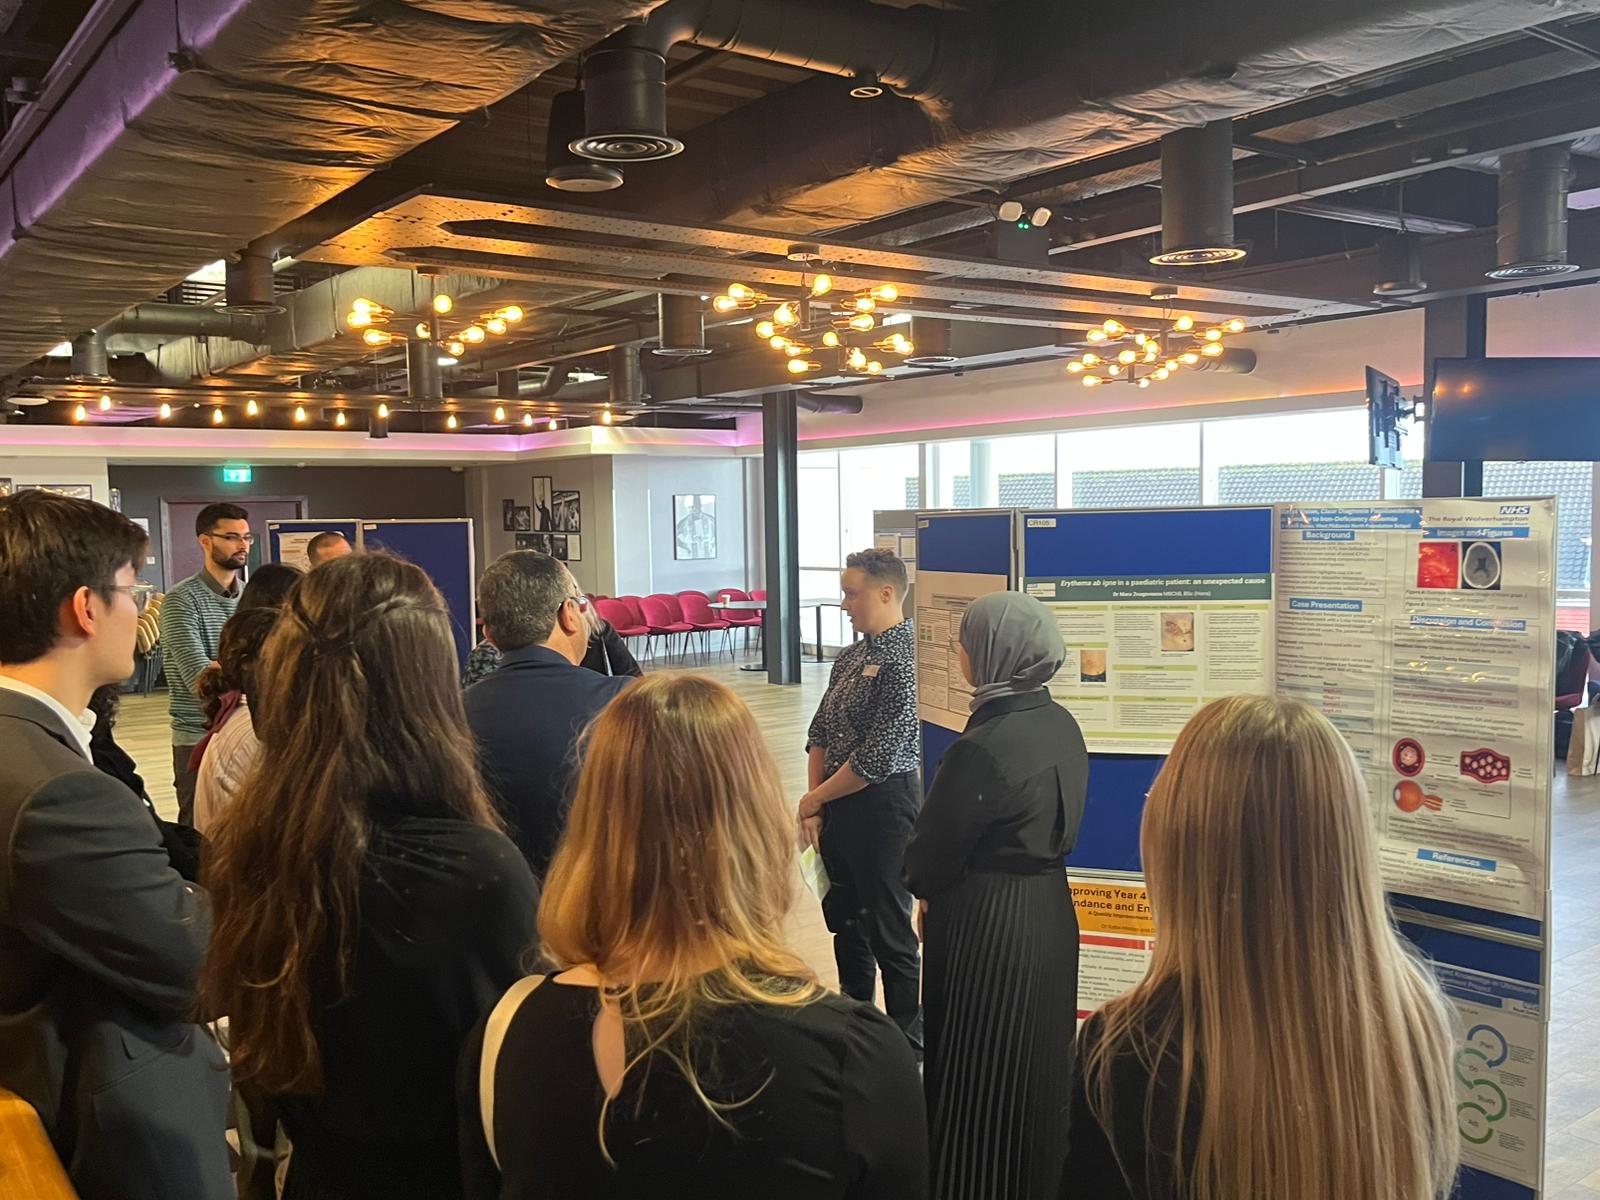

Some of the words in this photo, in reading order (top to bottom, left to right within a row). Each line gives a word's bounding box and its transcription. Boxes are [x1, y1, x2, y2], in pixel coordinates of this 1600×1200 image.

[1500, 506, 1530, 514] NHS
[1305, 530, 1352, 540] Background
[1060, 579, 1092, 588] Erythema
[1103, 579, 1117, 588] igne
[1131, 578, 1164, 587] paediatric
[1291, 600, 1309, 608] Case
[1310, 601, 1360, 610] Presentation
[1412, 616, 1457, 626] Discussion
[1475, 619, 1524, 629] Consion
[1432, 852, 1481, 867] References
[1069, 888, 1112, 899] proving
[1114, 890, 1138, 900] Year
[1139, 892, 1147, 900] 4
[1074, 899, 1113, 910] ndance
[1115, 903, 1135, 912] and
[1137, 904, 1150, 913] En
